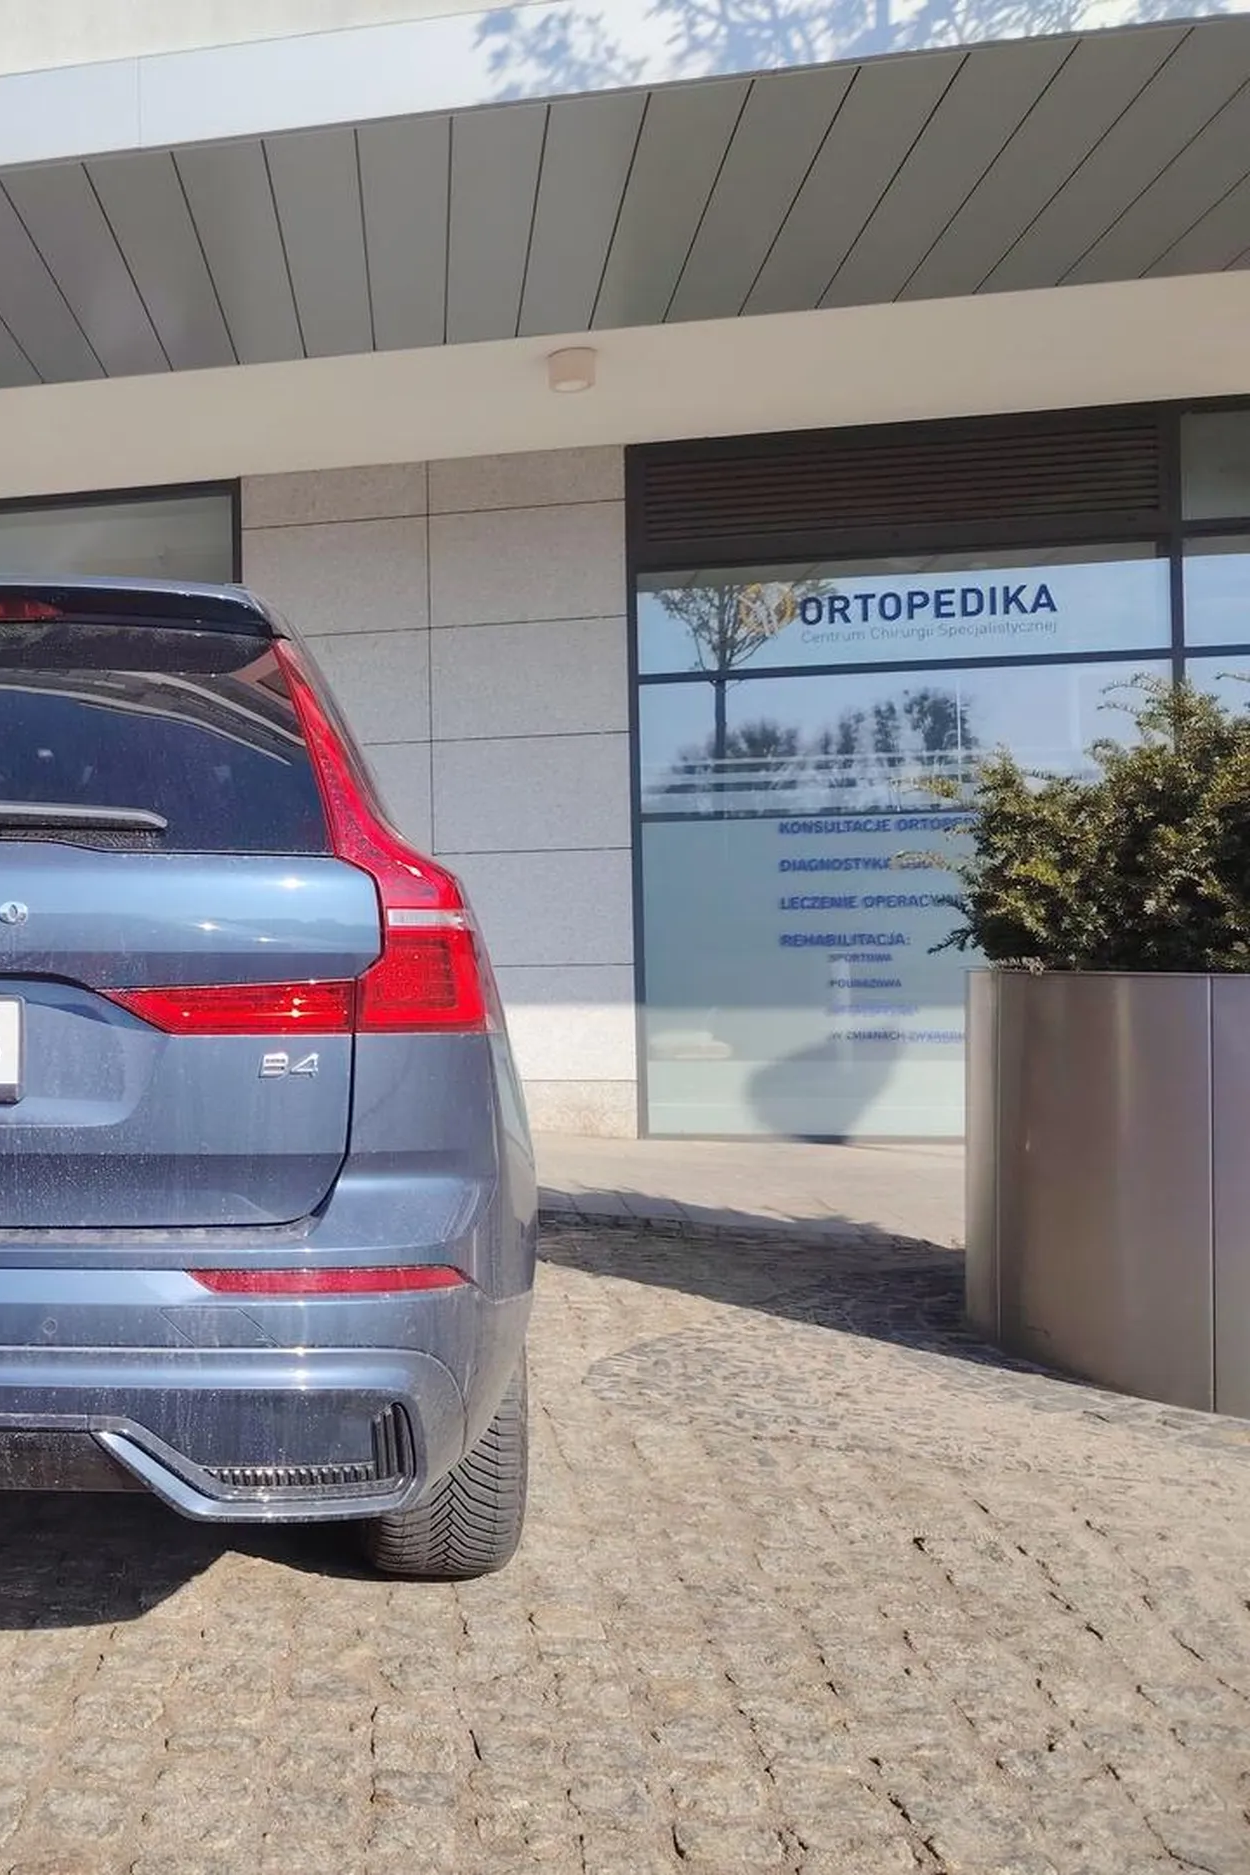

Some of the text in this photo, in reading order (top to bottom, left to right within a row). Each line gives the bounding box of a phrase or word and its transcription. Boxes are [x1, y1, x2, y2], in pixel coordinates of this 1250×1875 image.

[801, 584, 1058, 625] ORTOPEDIKA
[801, 630, 866, 644] Centrum
[938, 620, 1058, 638] Specjalistycznej
[779, 818, 891, 834] KONSULTACJE
[780, 895, 859, 910] LECZENIE
[780, 932, 912, 948] REHABILITACJA:
[259, 1052, 319, 1079] B4
